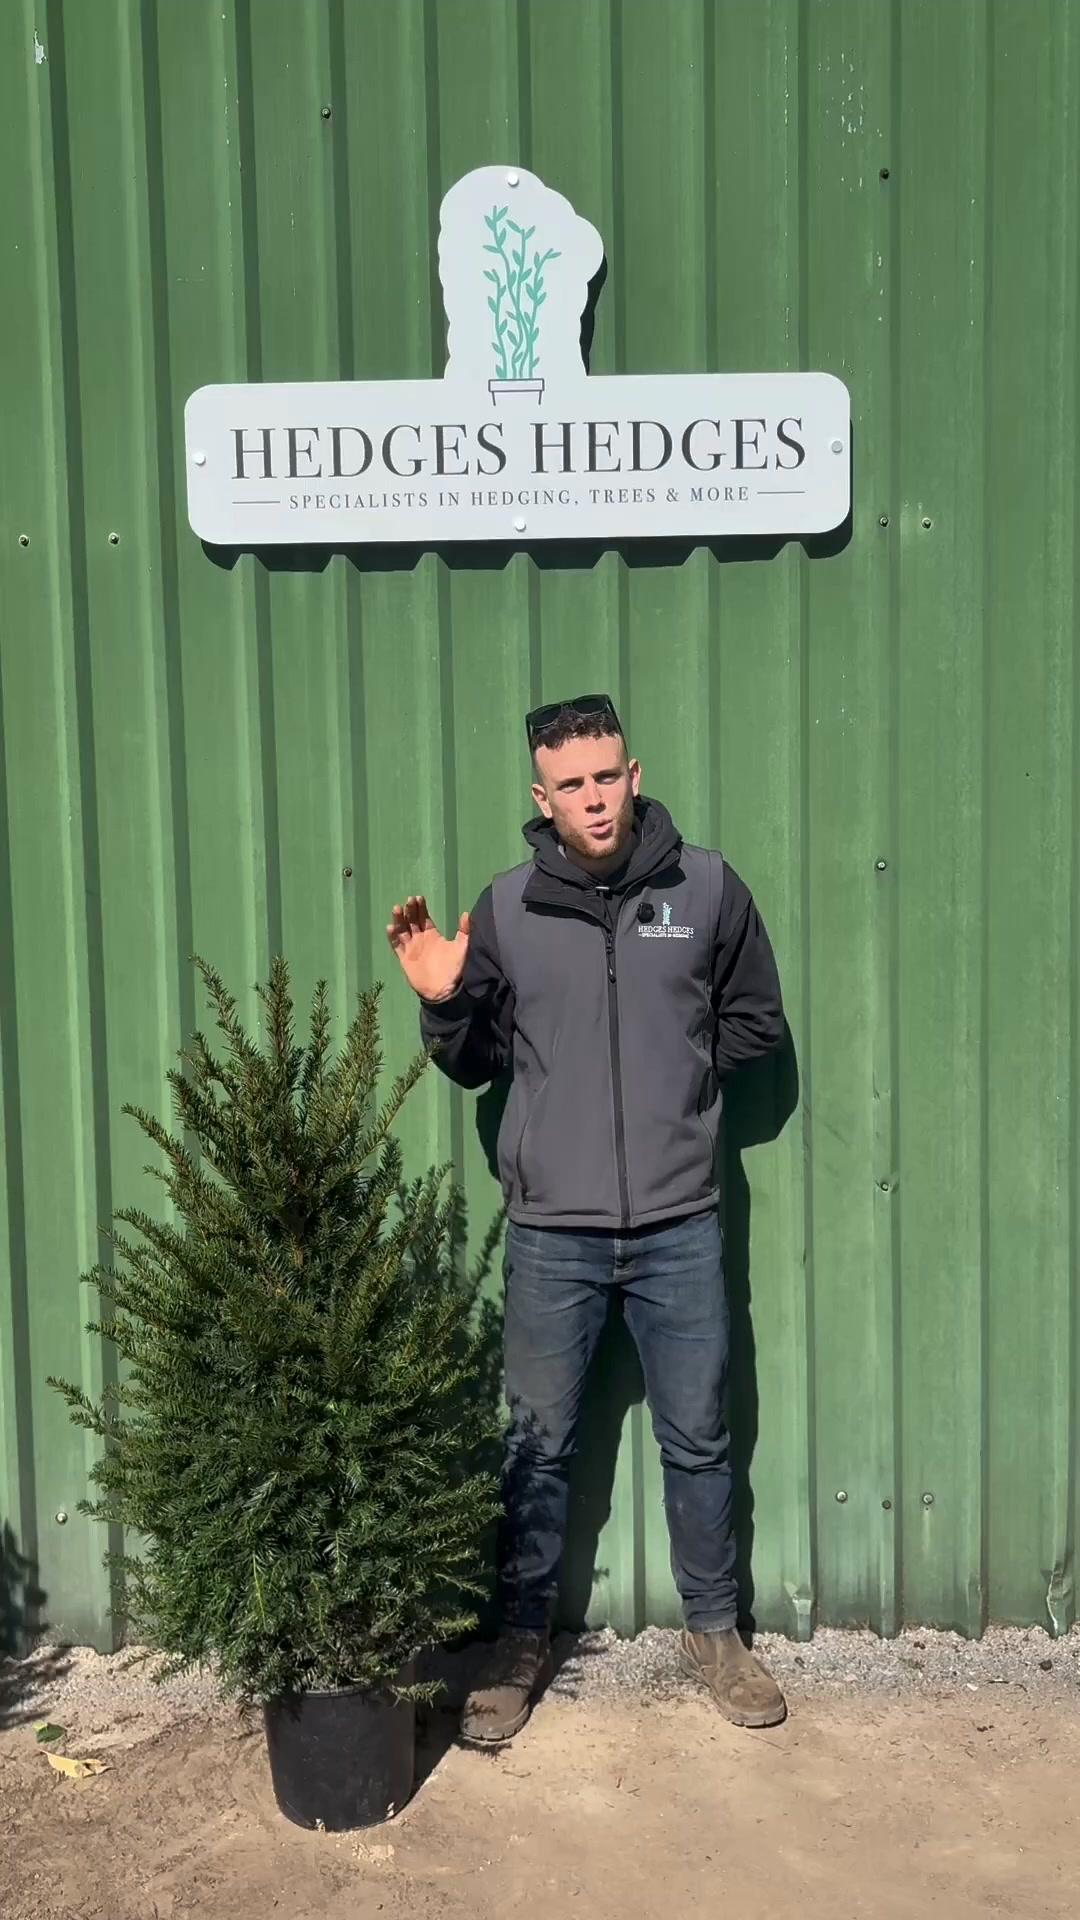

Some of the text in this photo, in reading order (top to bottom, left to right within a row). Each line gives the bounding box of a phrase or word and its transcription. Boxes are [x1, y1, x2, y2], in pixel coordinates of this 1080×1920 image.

[230, 417, 806, 479] HEDGES HEDGES
[290, 487, 749, 509] SPECIALISTS IN HEDGING, TREES & MORE
